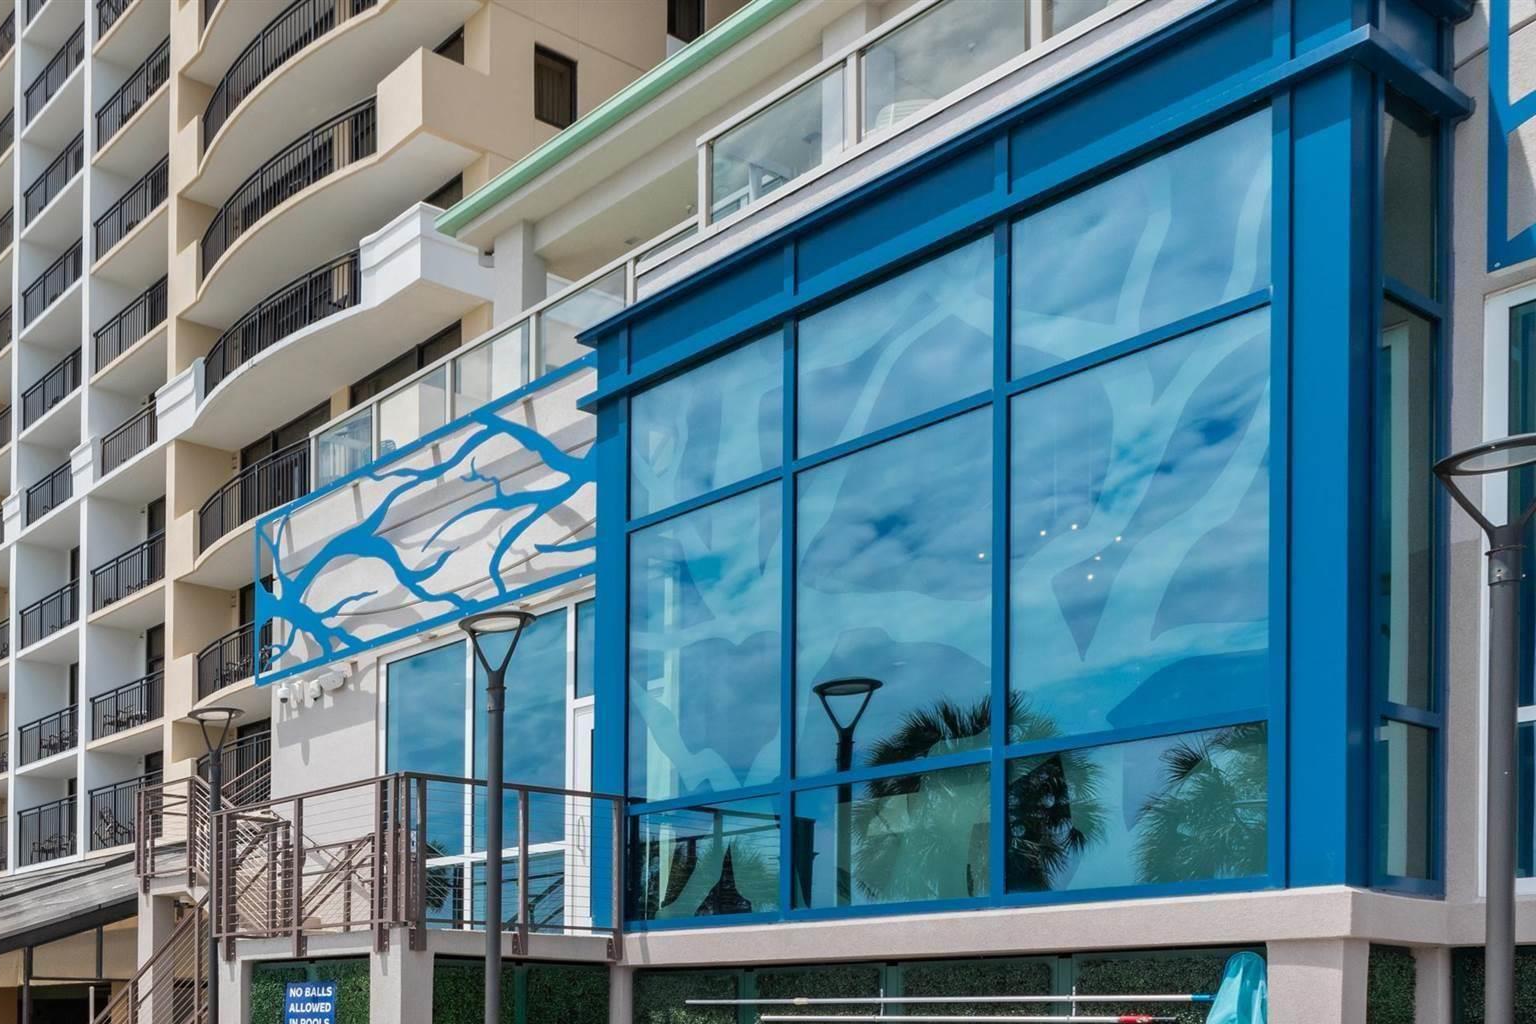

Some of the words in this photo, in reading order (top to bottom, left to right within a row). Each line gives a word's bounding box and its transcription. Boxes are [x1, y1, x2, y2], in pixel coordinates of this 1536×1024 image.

[289, 987, 303, 997] NO
[305, 986, 333, 997] BALLS
[289, 1002, 332, 1013] ALLOWED
